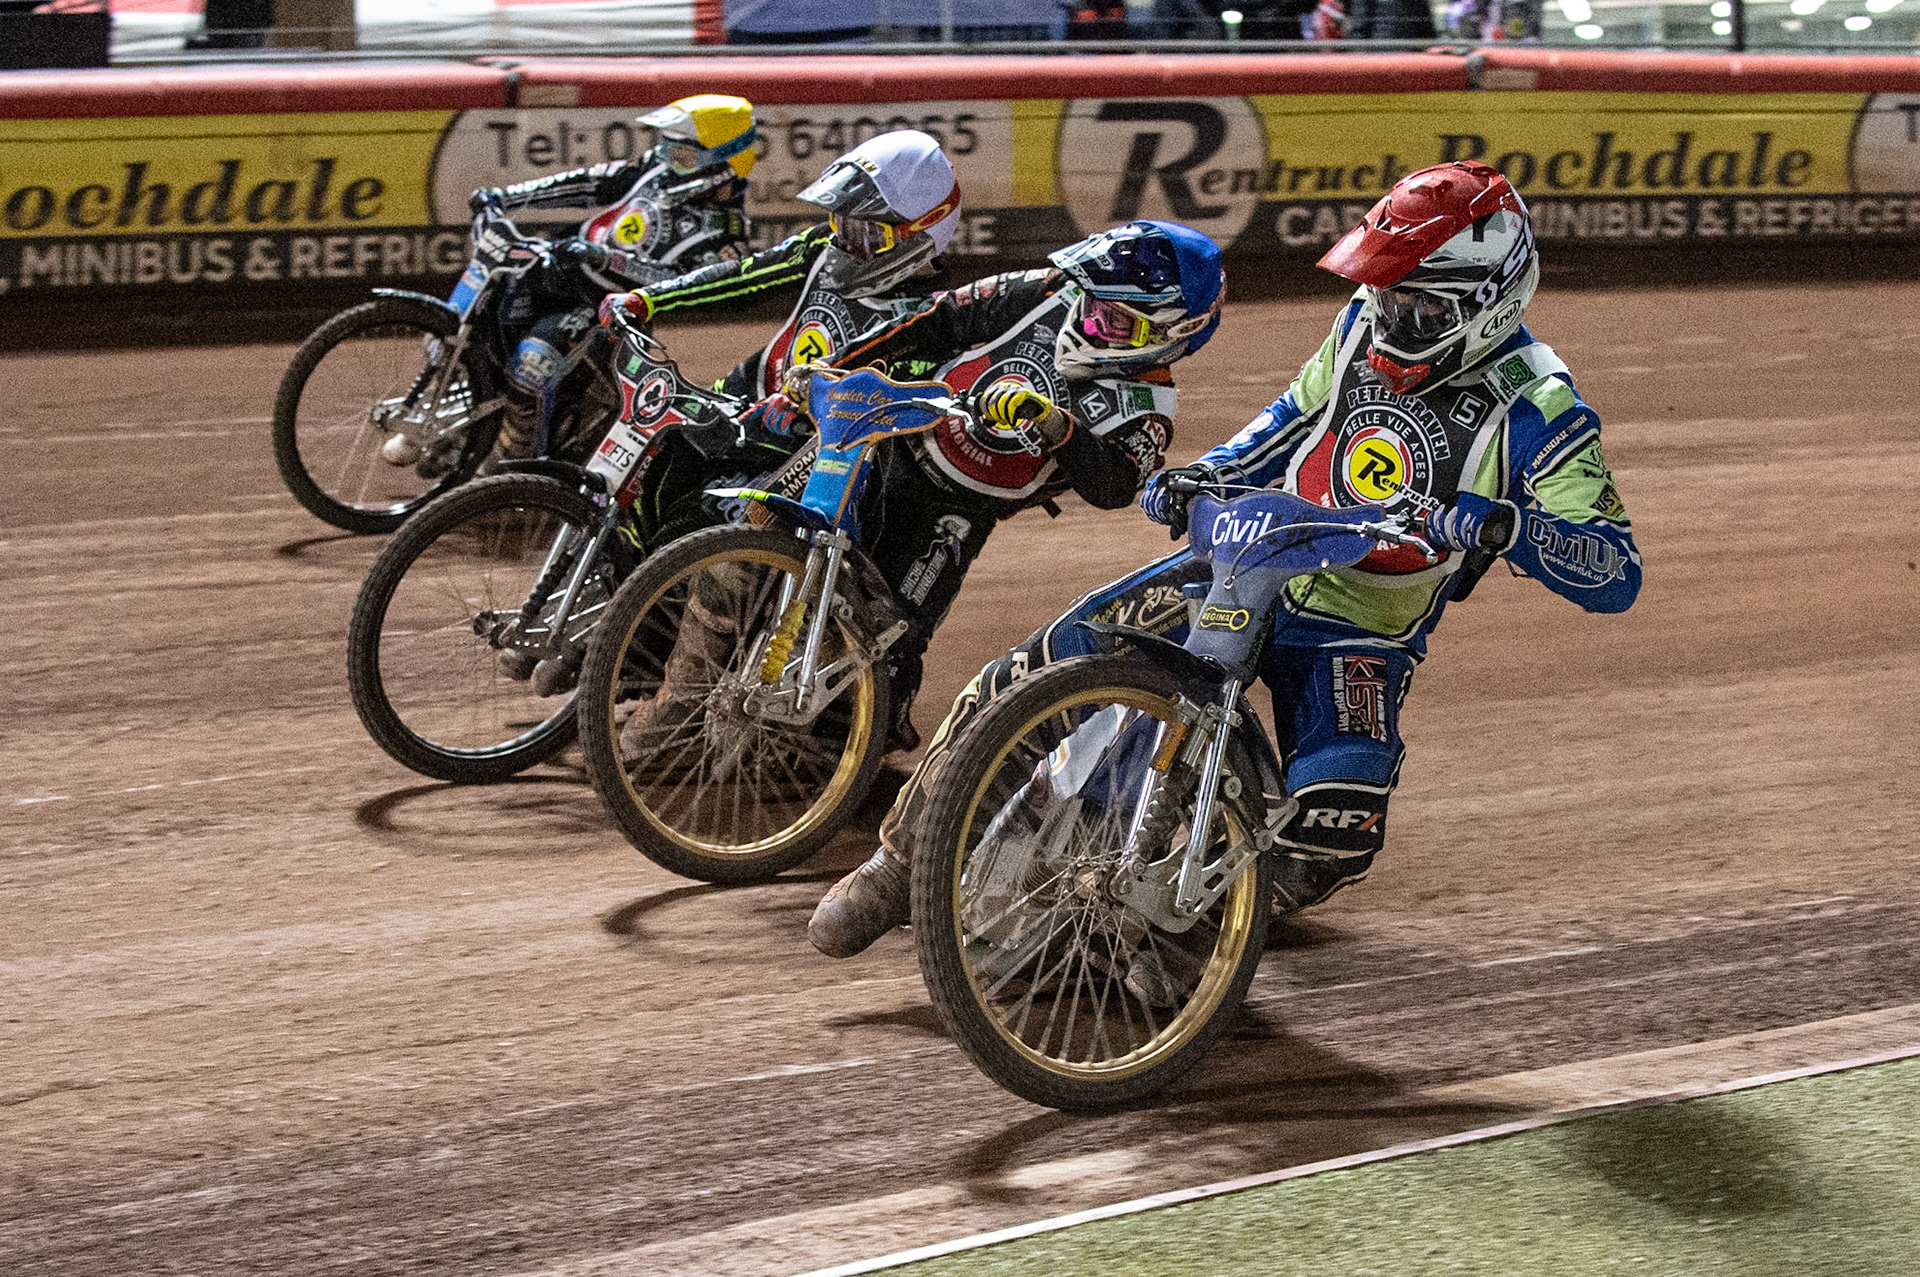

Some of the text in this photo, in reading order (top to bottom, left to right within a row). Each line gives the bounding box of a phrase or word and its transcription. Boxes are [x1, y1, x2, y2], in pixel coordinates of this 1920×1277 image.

[485, 120, 588, 168] Tel:
[4, 158, 387, 230] ochdale
[20, 232, 473, 287] MINIBUS & REFRIG
[1003, 363, 1033, 378] BELLE
[1346, 385, 1452, 462] PETER CRAVEN
[1455, 399, 1481, 429] 5
[948, 417, 995, 468] MORIAL
[1346, 412, 1427, 480] BELLE VUE ACES
[1356, 447, 1445, 511] Rentruck
[1211, 510, 1273, 546] Civil
[1202, 611, 1231, 623] REGINA
